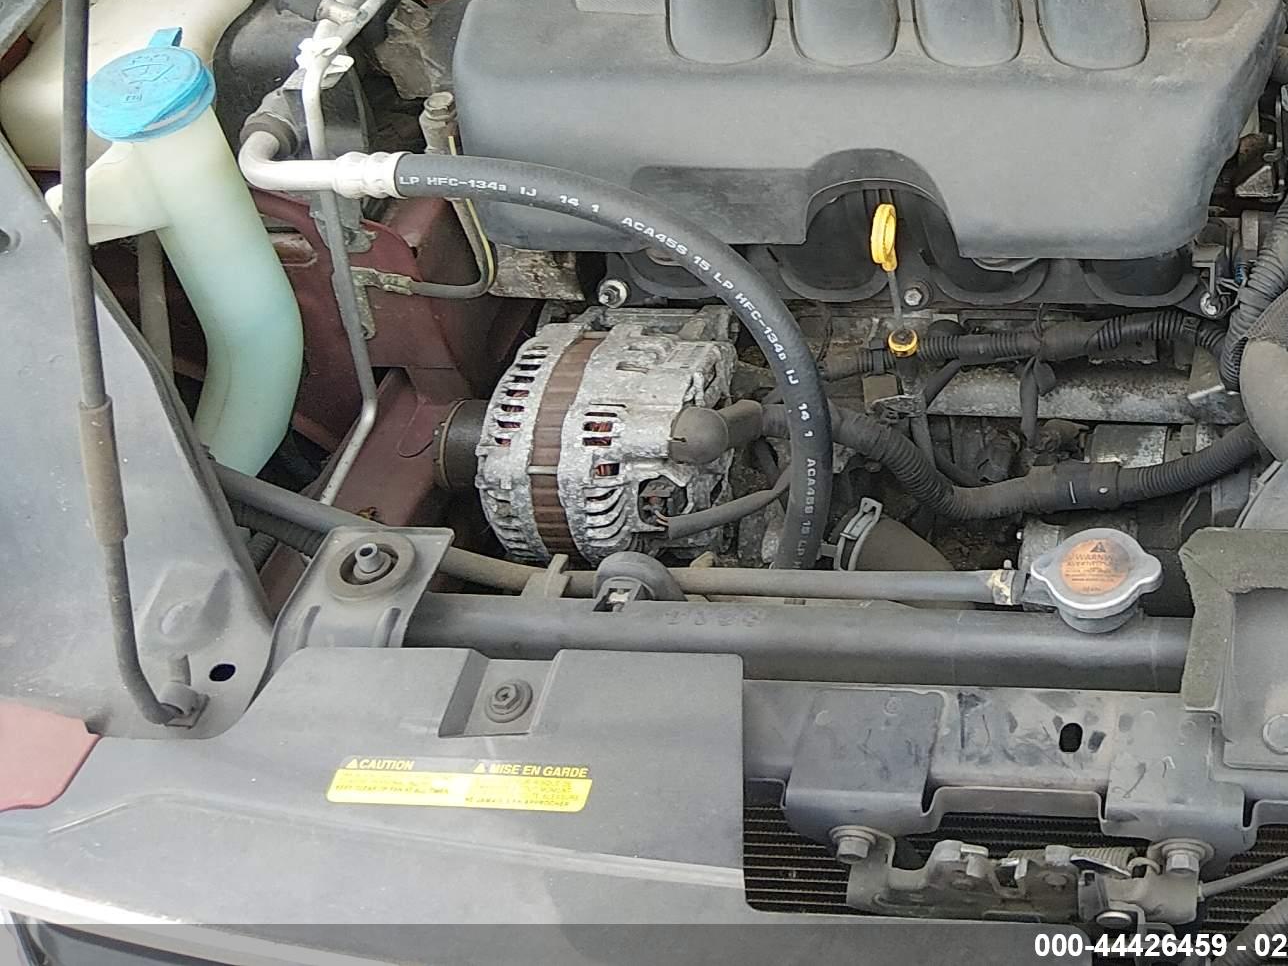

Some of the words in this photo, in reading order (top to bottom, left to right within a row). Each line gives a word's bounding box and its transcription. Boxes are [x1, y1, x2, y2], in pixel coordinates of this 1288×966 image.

[399, 176, 420, 185] LP
[692, 254, 712, 272] 15
[713, 272, 735, 291] LP
[358, 759, 415, 770] CAUTION
[488, 762, 522, 774] MISE
[522, 763, 541, 776] EN
[542, 765, 589, 778] GARDE
